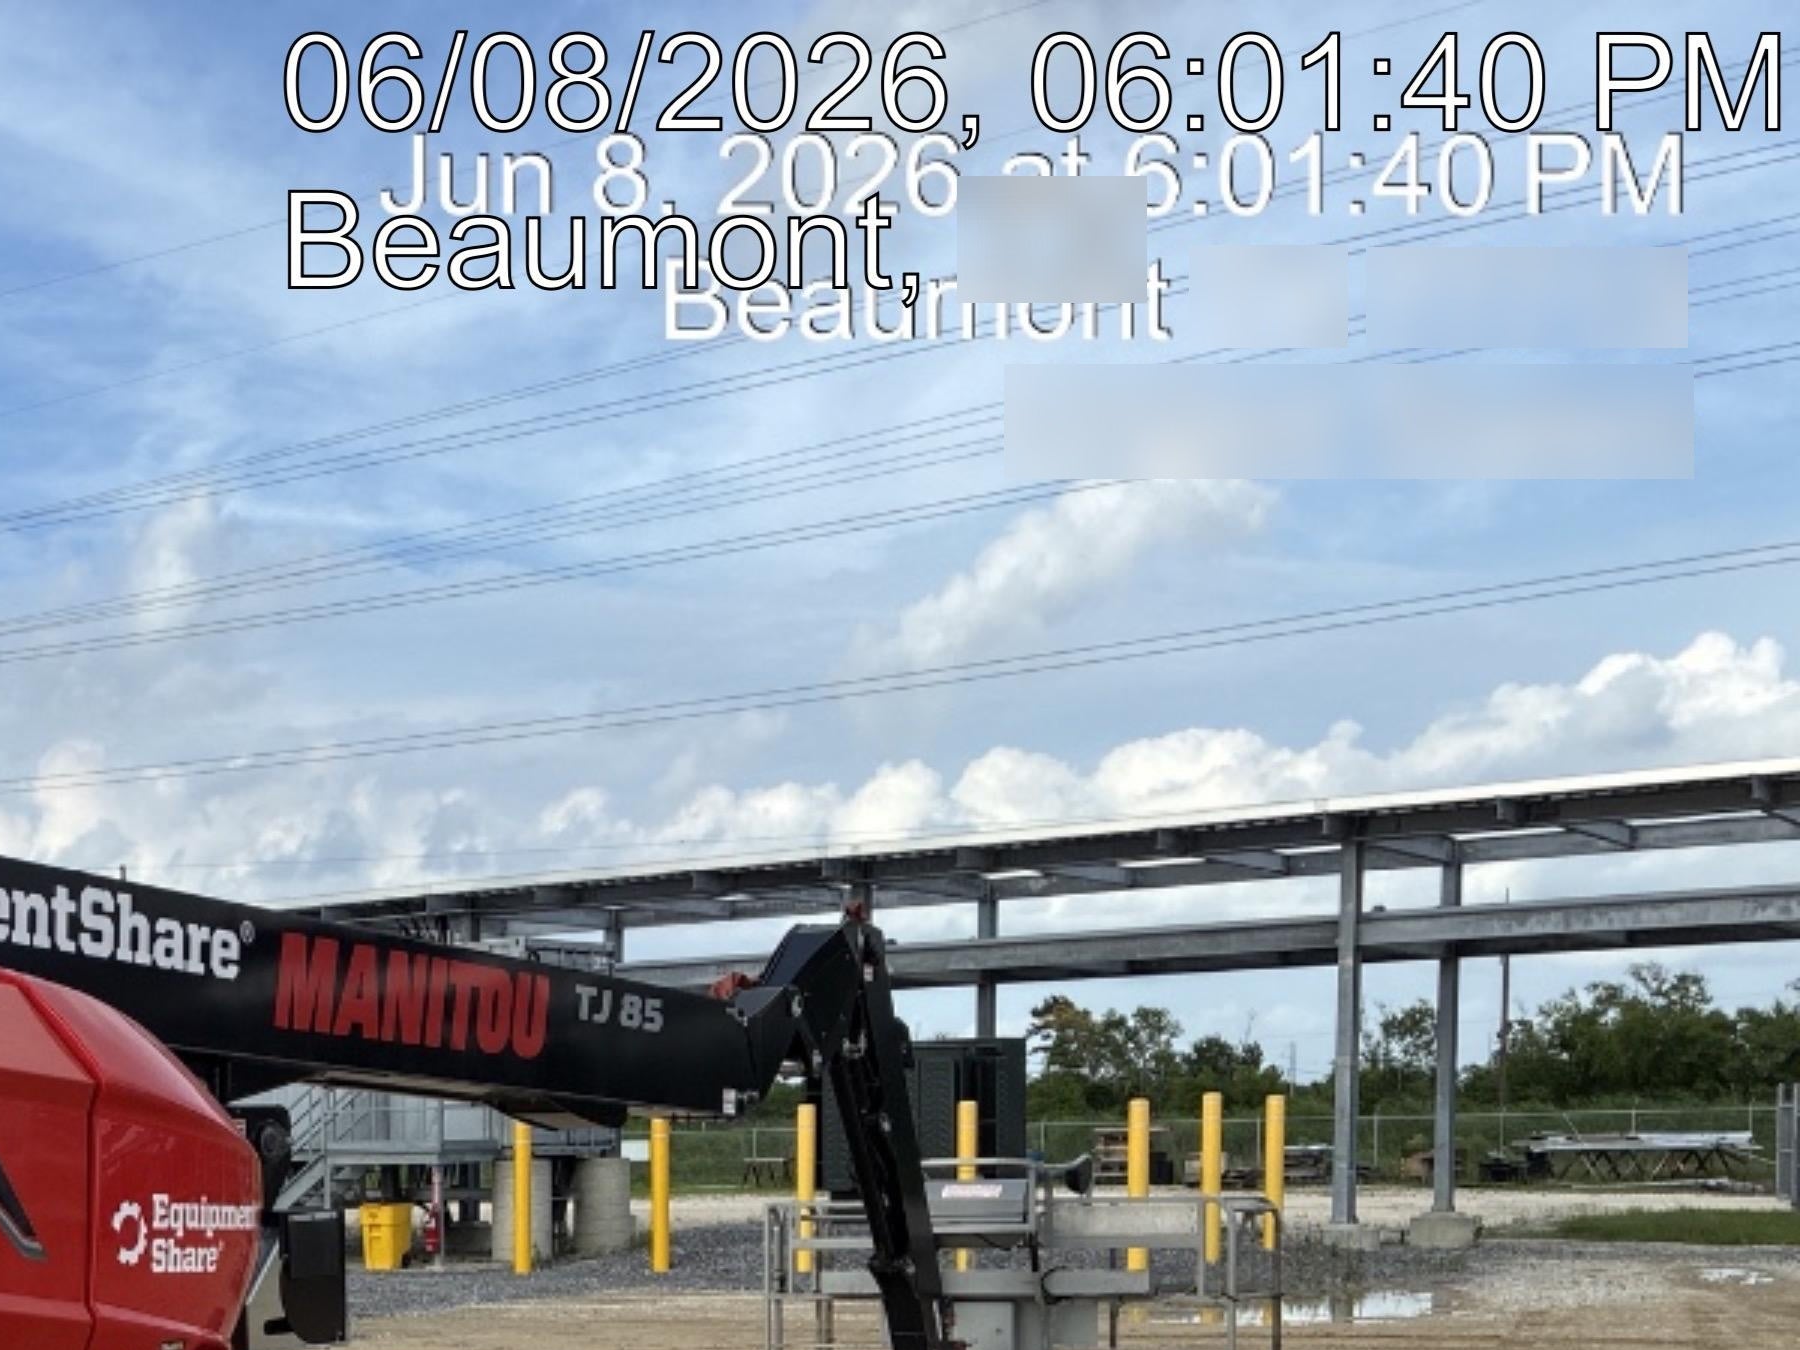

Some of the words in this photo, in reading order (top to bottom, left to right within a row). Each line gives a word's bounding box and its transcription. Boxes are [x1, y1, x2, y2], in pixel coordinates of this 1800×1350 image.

[274, 931, 551, 1060] MANITOU
[575, 983, 613, 1024] TJ
[620, 992, 664, 1033] 85
